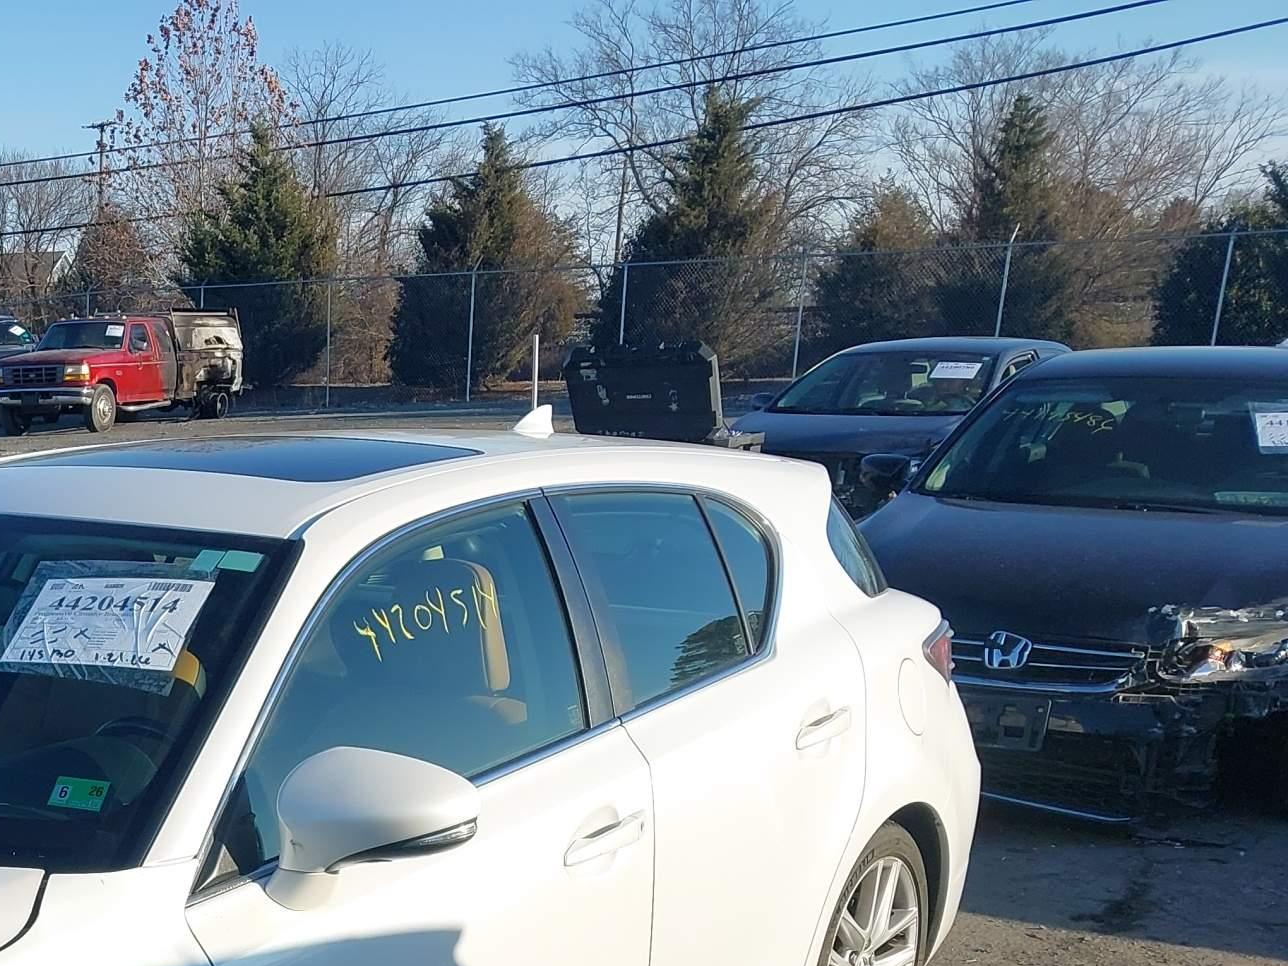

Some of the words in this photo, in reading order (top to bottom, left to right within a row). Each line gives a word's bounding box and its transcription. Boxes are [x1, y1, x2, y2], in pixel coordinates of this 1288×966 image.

[48, 594, 181, 614] 44204514
[353, 577, 498, 663] 44204514
[59, 786, 70, 799] 6
[88, 786, 105, 798] 26
